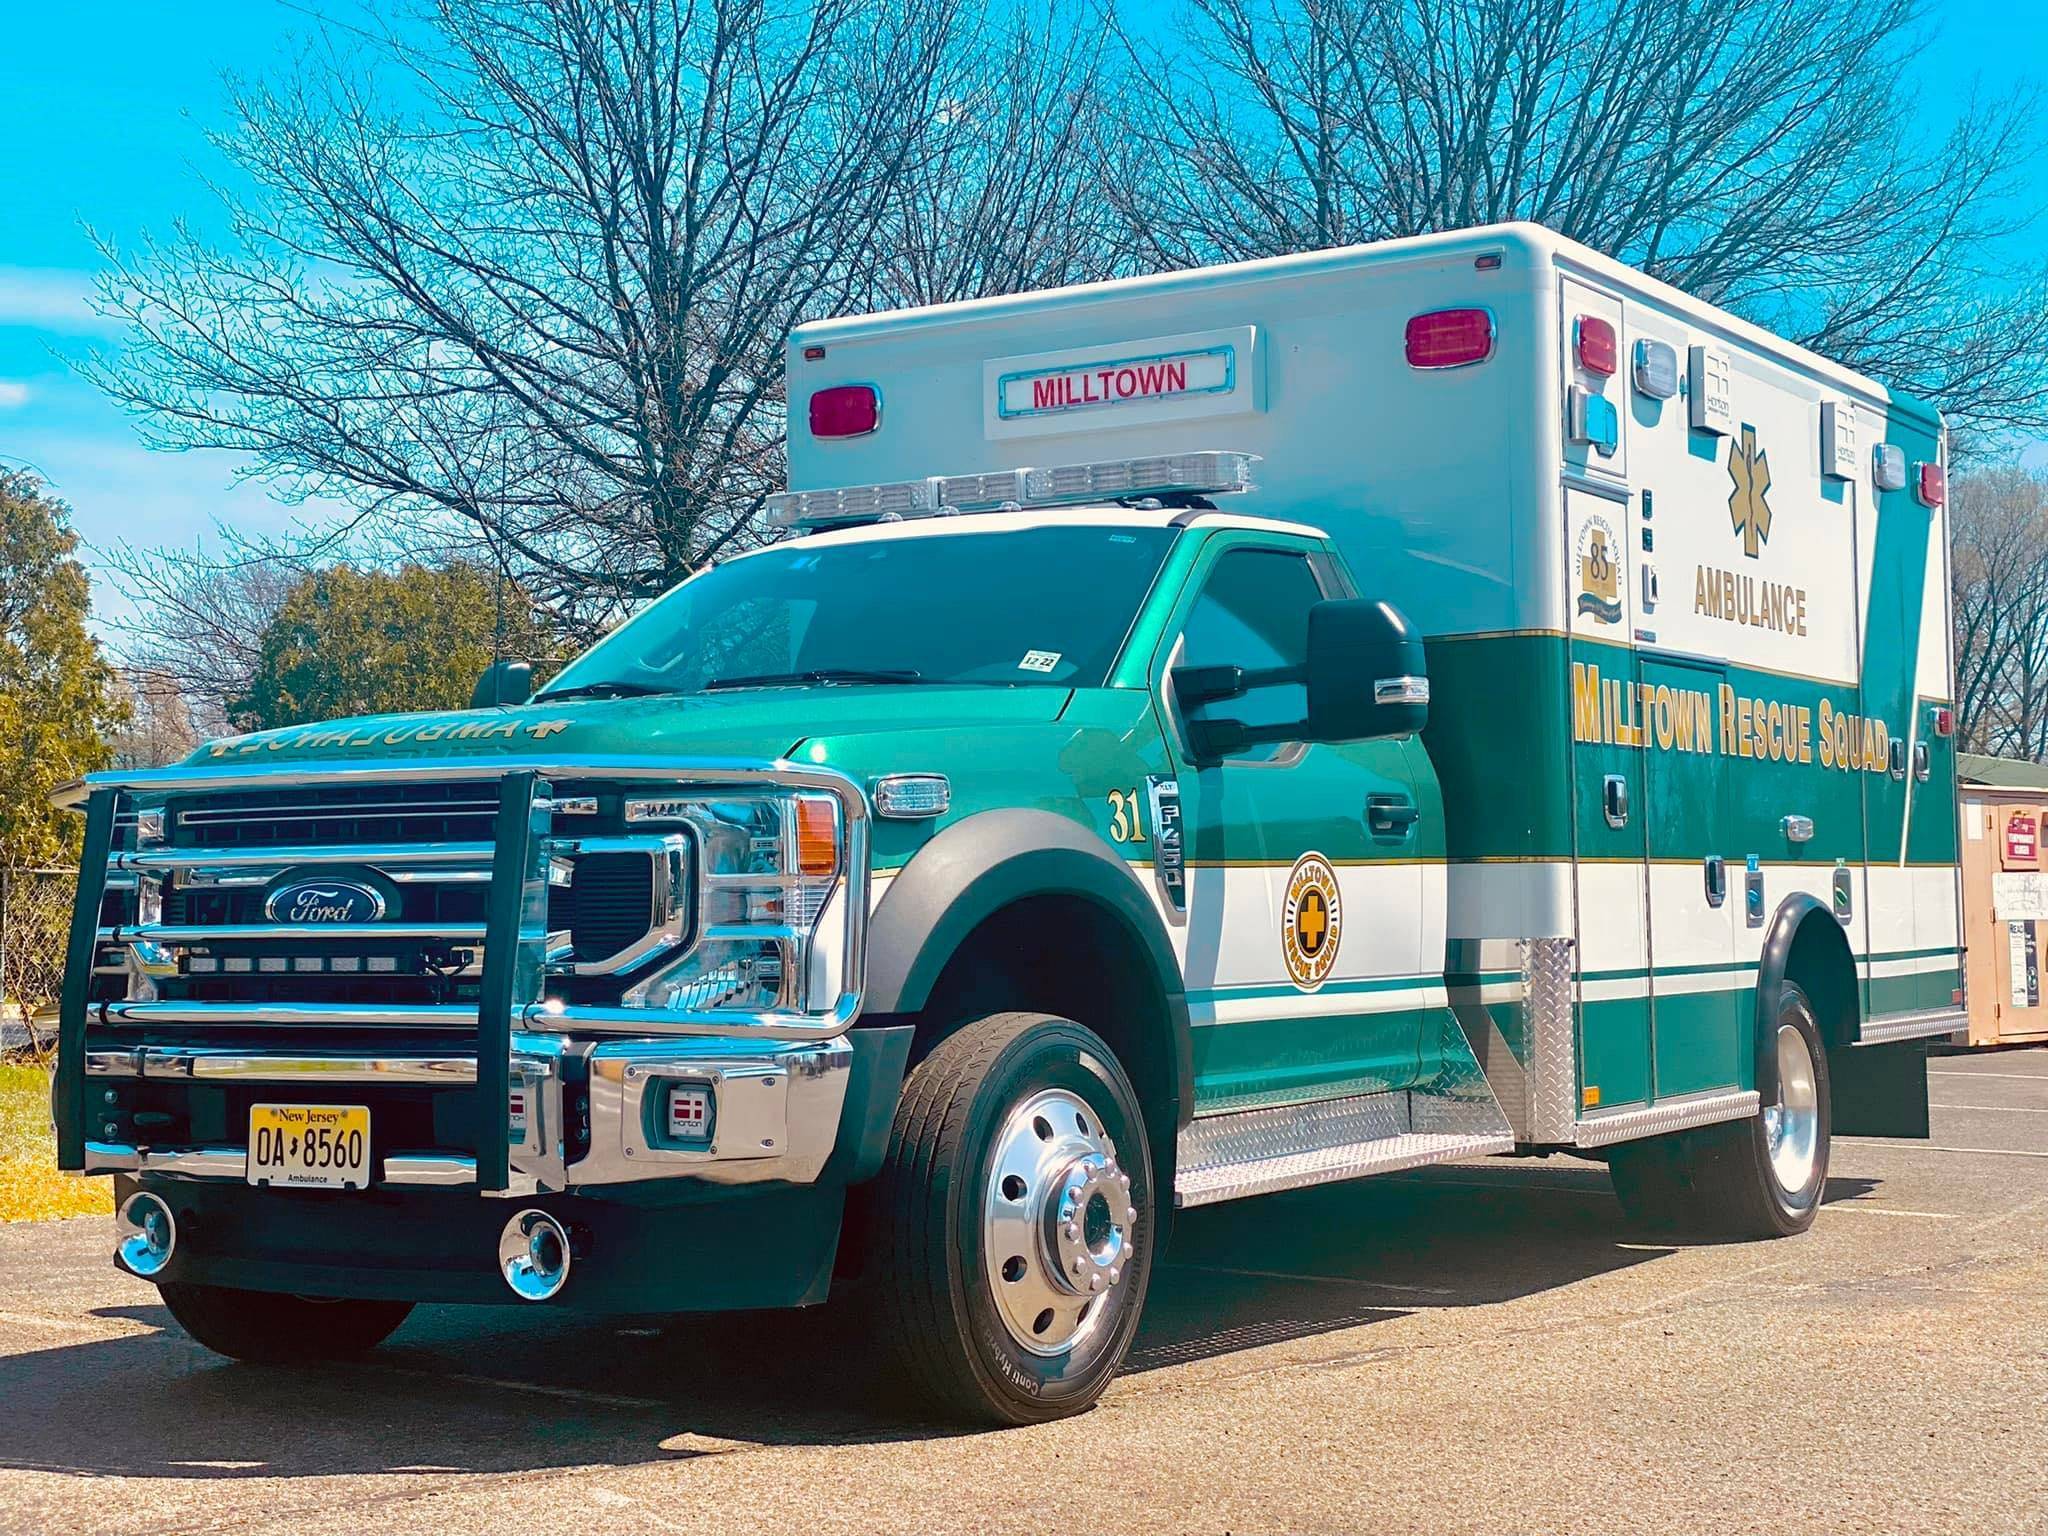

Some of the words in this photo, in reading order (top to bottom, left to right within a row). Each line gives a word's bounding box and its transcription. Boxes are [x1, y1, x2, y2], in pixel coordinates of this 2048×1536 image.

[1033, 362, 1186, 409] MILLTOWN
[1589, 542, 1609, 581] 85
[1694, 564, 1807, 637] AMBULANCE
[1024, 656, 1039, 665] 12
[1039, 657, 1055, 667] 22
[1572, 661, 1712, 754] MILLTOWN
[1718, 682, 1812, 765] RESCUE
[1818, 697, 1889, 773] SQUAD
[1106, 788, 1147, 843] 31
[1290, 865, 1336, 901] MILLTOWN
[290, 889, 354, 922] Ford
[1286, 925, 1313, 980] RESCUE
[1314, 924, 1338, 977] SQUAD
[279, 1108, 304, 1122] New
[305, 1109, 340, 1125] Jersey
[303, 1128, 362, 1169] 8560
[287, 1173, 328, 1183] Ambulance
[983, 1328, 1012, 1376] Hybrid
[1010, 1370, 1039, 1396] Conti
